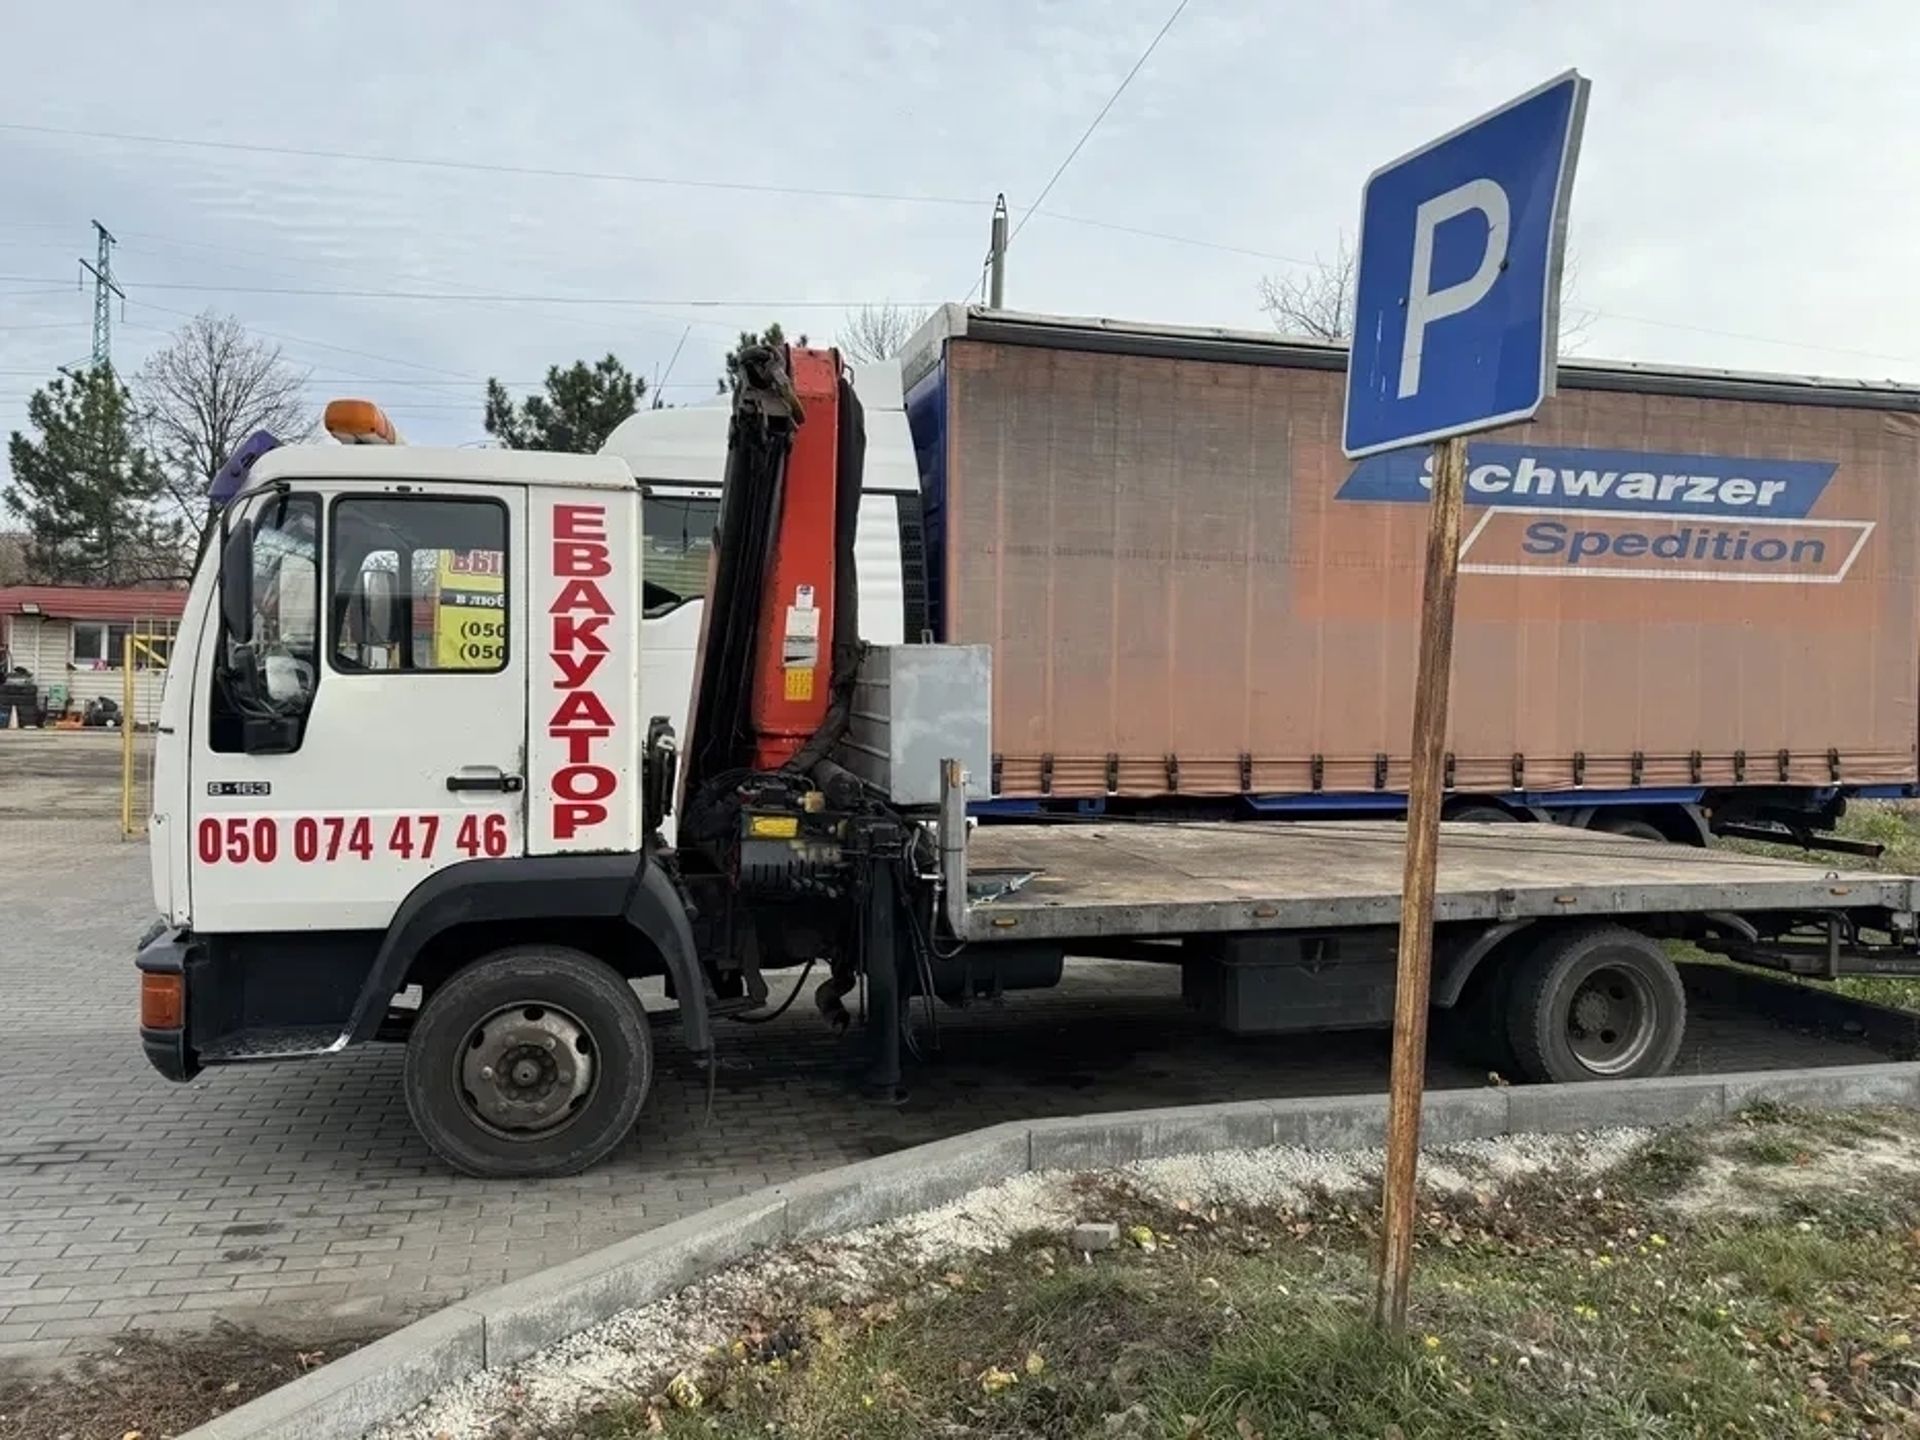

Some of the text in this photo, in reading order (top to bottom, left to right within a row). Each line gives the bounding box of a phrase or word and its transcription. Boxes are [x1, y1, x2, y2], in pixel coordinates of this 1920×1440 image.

[1398, 178, 1510, 399] P
[1522, 521, 1825, 564] Spedition
[548, 504, 617, 840] ЕВАКУАТОР
[199, 813, 507, 863] 050 074 47 46
